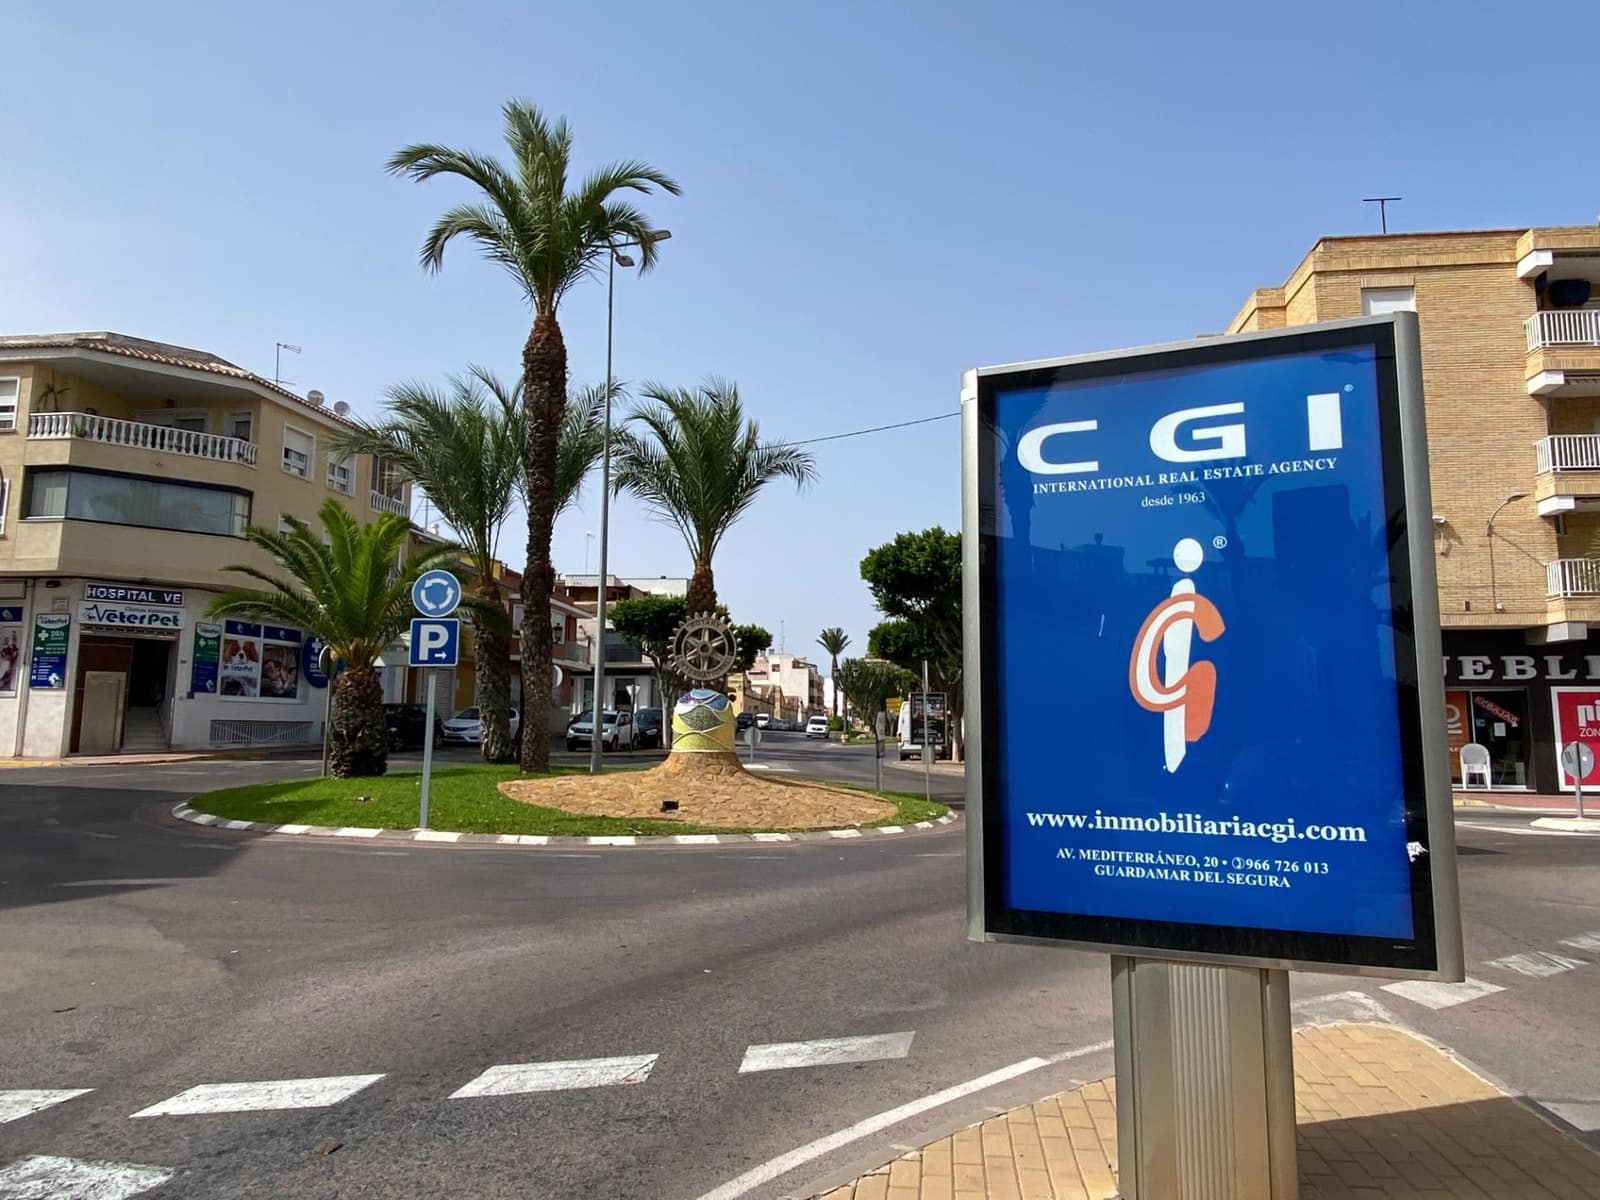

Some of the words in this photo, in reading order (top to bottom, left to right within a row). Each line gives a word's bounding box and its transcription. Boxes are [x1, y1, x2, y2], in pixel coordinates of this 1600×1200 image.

[1033, 475, 1154, 494] INTERNATIONAL
[1158, 470, 1199, 485] REAL
[1204, 463, 1264, 480] ESTATE
[1268, 457, 1337, 475] AGENCY
[1141, 495, 1174, 508] desde
[1178, 492, 1206, 505] 1963
[87, 587, 157, 602] HOSPITAL
[163, 593, 182, 604] VE
[418, 624, 449, 661] P
[1443, 655, 1600, 680] EBL
[1026, 809, 1367, 844] www.inmobiliariacgi.com
[1056, 847, 1076, 860] AV.
[1079, 849, 1201, 869] MEDITERRÁNEO,
[1203, 856, 1219, 868] 20
[1245, 858, 1271, 871] 966
[1274, 860, 1300, 873] 726
[1304, 862, 1329, 875] 013
[1094, 864, 1191, 882] GUARDAMAR
[1194, 871, 1225, 884] DEL
[1226, 872, 1291, 888] SEGURA
